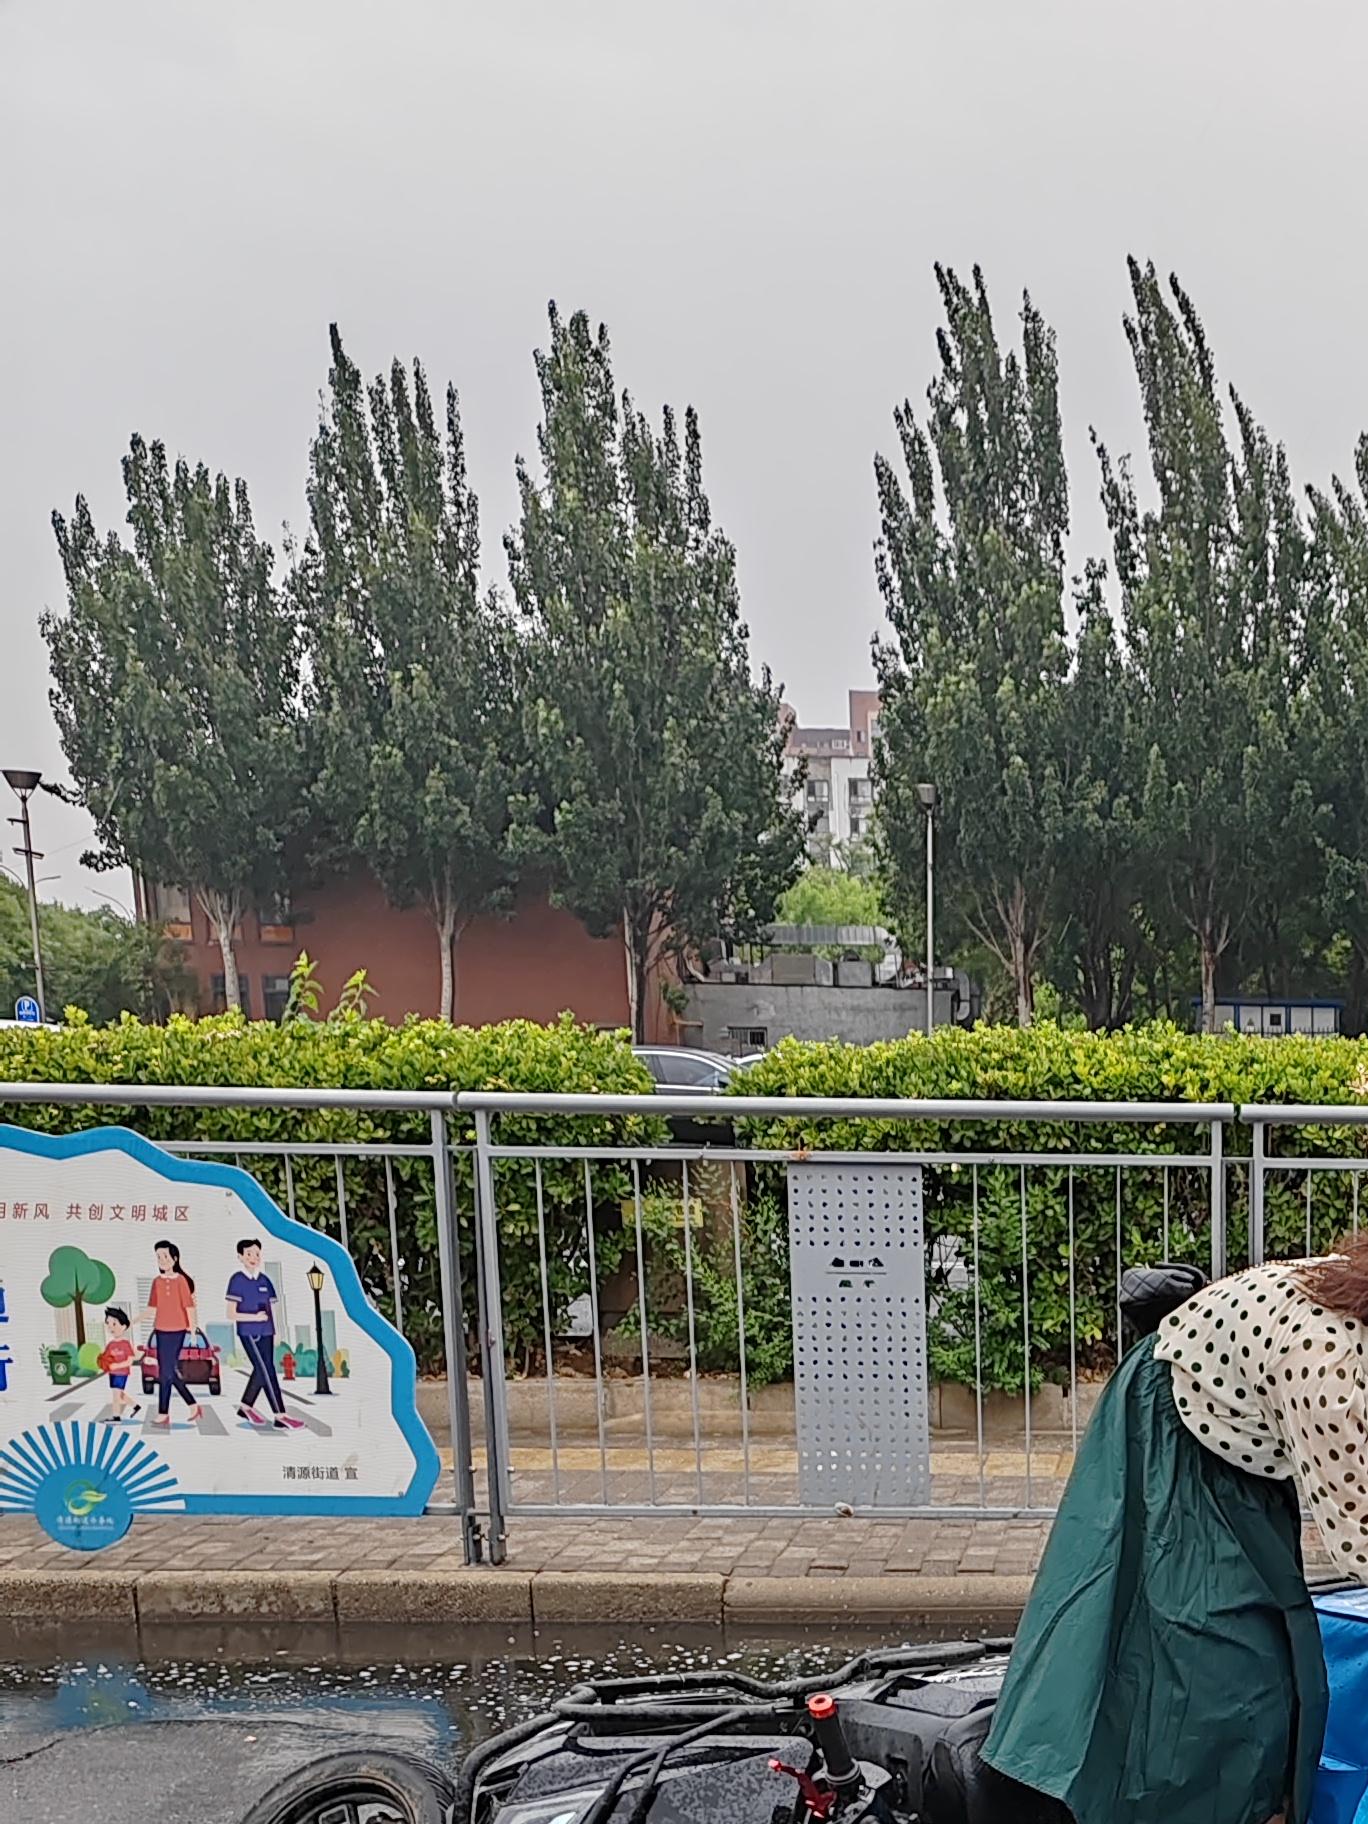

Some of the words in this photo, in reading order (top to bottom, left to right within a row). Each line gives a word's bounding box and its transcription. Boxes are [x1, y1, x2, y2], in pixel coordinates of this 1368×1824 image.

[66, 1203, 190, 1222] 共创文明城区
[282, 1465, 339, 1481] 清源街道
[344, 1466, 358, 1480] 宣
